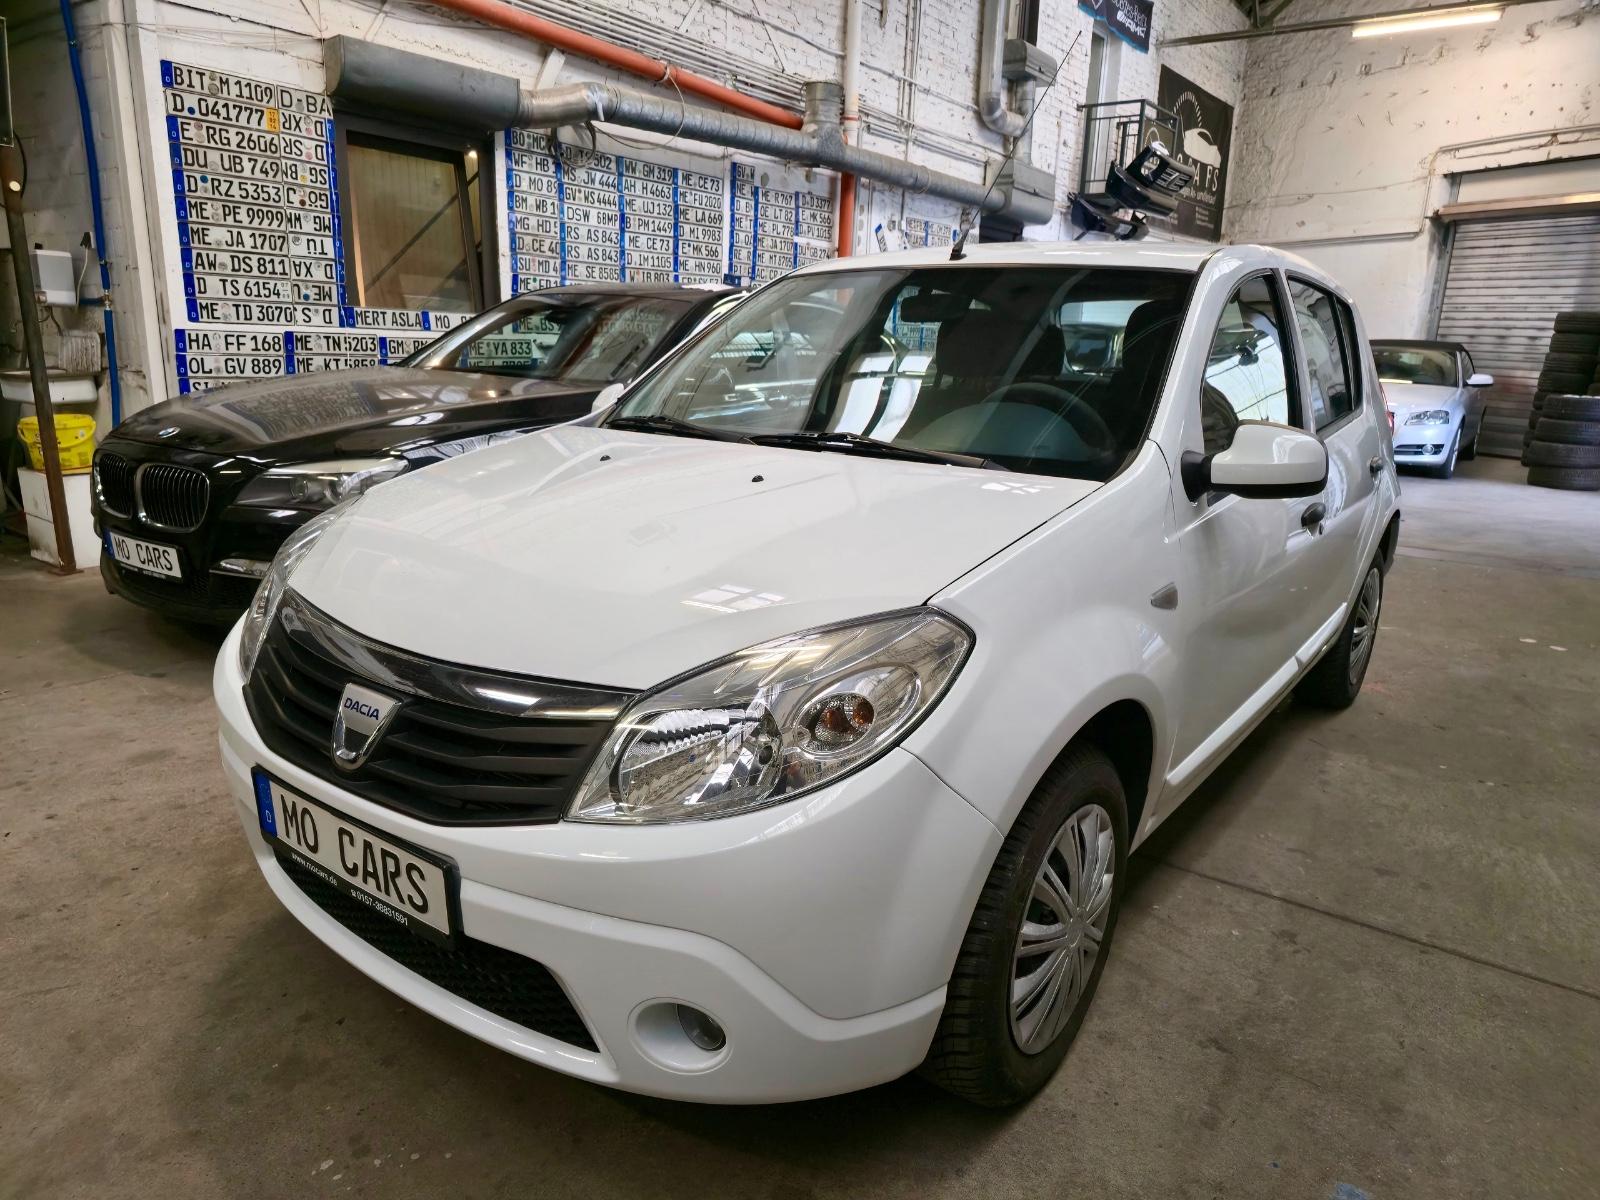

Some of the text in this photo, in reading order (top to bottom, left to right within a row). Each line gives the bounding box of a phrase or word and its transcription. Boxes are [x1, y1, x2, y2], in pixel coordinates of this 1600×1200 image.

[173, 66, 273, 104] BIT M 1109
[280, 89, 292, 108] D
[172, 93, 265, 127] D 041777
[180, 122, 278, 154] E RG 2606
[182, 148, 279, 178] DU UB 749
[513, 152, 549, 172] WF HB
[514, 174, 543, 192] D MO
[583, 171, 616, 190] JW 444
[656, 167, 673, 182] 319
[682, 172, 720, 192] ME CE 73
[186, 175, 281, 204] D RZ 5353
[565, 187, 576, 202] GV
[624, 178, 636, 194] AH
[650, 184, 671, 200] 4663
[188, 201, 284, 229] ME PE 9999
[567, 206, 590, 223] DSW
[656, 203, 673, 217] 132
[680, 207, 723, 226] ME LA 669
[515, 216, 530, 231] MG
[638, 217, 650, 232] PM
[190, 228, 286, 252] ME JA 1707
[567, 225, 619, 245] RS AS 843
[628, 235, 670, 252] ME CE 73
[517, 236, 546, 254] D CE
[567, 245, 619, 263] RS AS 843
[681, 242, 687, 255] E
[194, 252, 289, 276] AW DS 811
[519, 257, 550, 274] SU MD
[627, 252, 633, 266] D
[567, 264, 596, 279] ME SE
[197, 277, 281, 299] D TS 6154
[199, 302, 293, 323] ME TD 3070
[355, 310, 422, 327] MERT ASLA
[435, 314, 450, 329] MO
[188, 333, 282, 352] HA FF 168
[295, 335, 312, 350] ME
[323, 336, 342, 351] TN
[388, 339, 405, 355] GM
[469, 341, 532, 356] ME 833
[188, 357, 282, 375] OL GV 889
[296, 357, 314, 372] ME
[114, 536, 173, 572] MO CARS
[343, 697, 380, 721] DACIA
[280, 793, 429, 914] MO CARS
[291, 852, 338, 887] www.mocars.de
